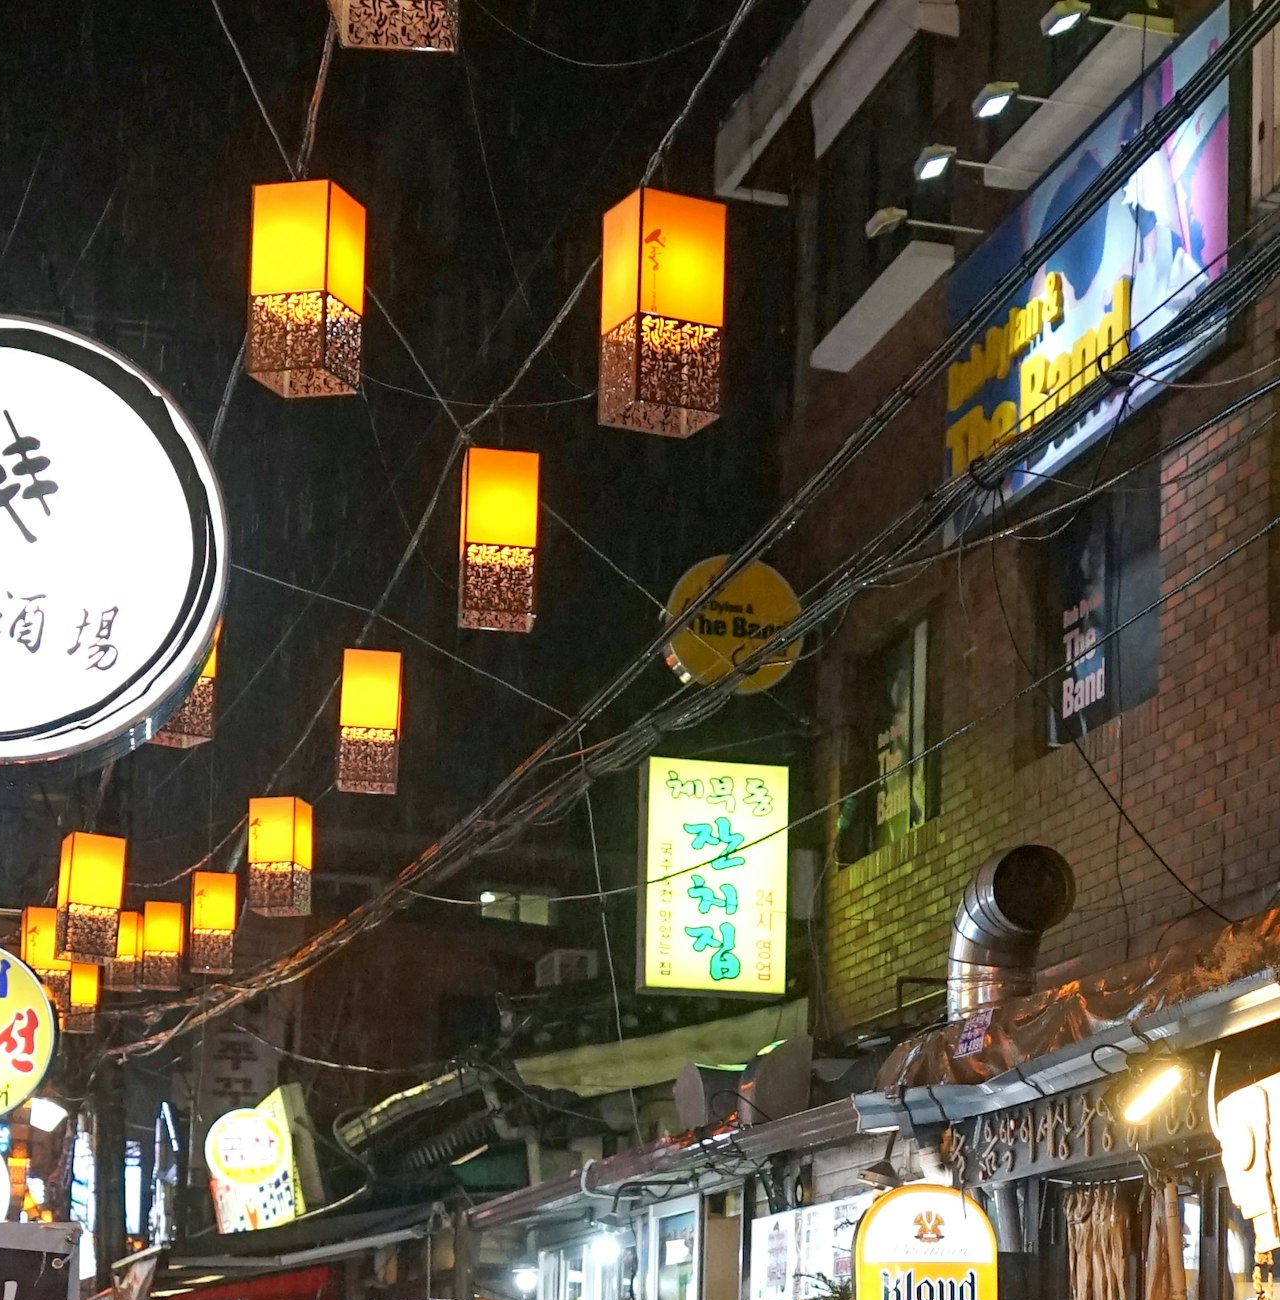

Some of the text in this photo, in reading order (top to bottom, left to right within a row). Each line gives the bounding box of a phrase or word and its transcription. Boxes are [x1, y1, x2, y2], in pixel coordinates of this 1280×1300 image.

[1042, 270, 1063, 323] &
[1020, 273, 1132, 433] Band
[1062, 626, 1097, 672] The
[1062, 656, 1106, 720] Band
[666, 770, 774, 818] 체부동
